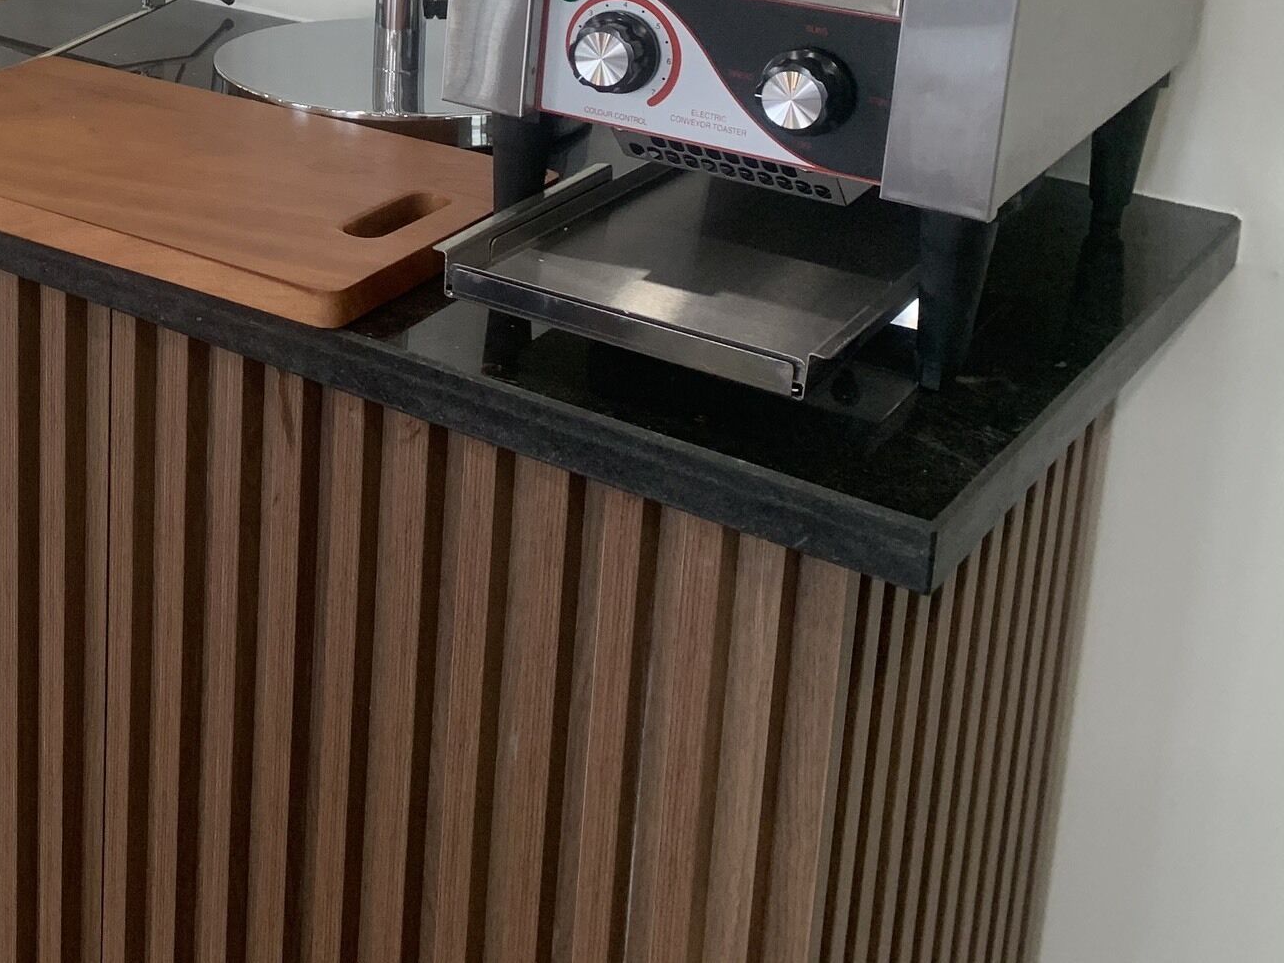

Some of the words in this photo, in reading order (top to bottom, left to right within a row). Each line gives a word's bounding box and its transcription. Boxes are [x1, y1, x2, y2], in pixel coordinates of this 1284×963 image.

[583, 105, 613, 118] COLOUR
[614, 112, 647, 126] CONTROL
[670, 114, 712, 129] CONVEYOR
[713, 123, 747, 137] TOASTER
[691, 109, 727, 123] ELECTRIC
